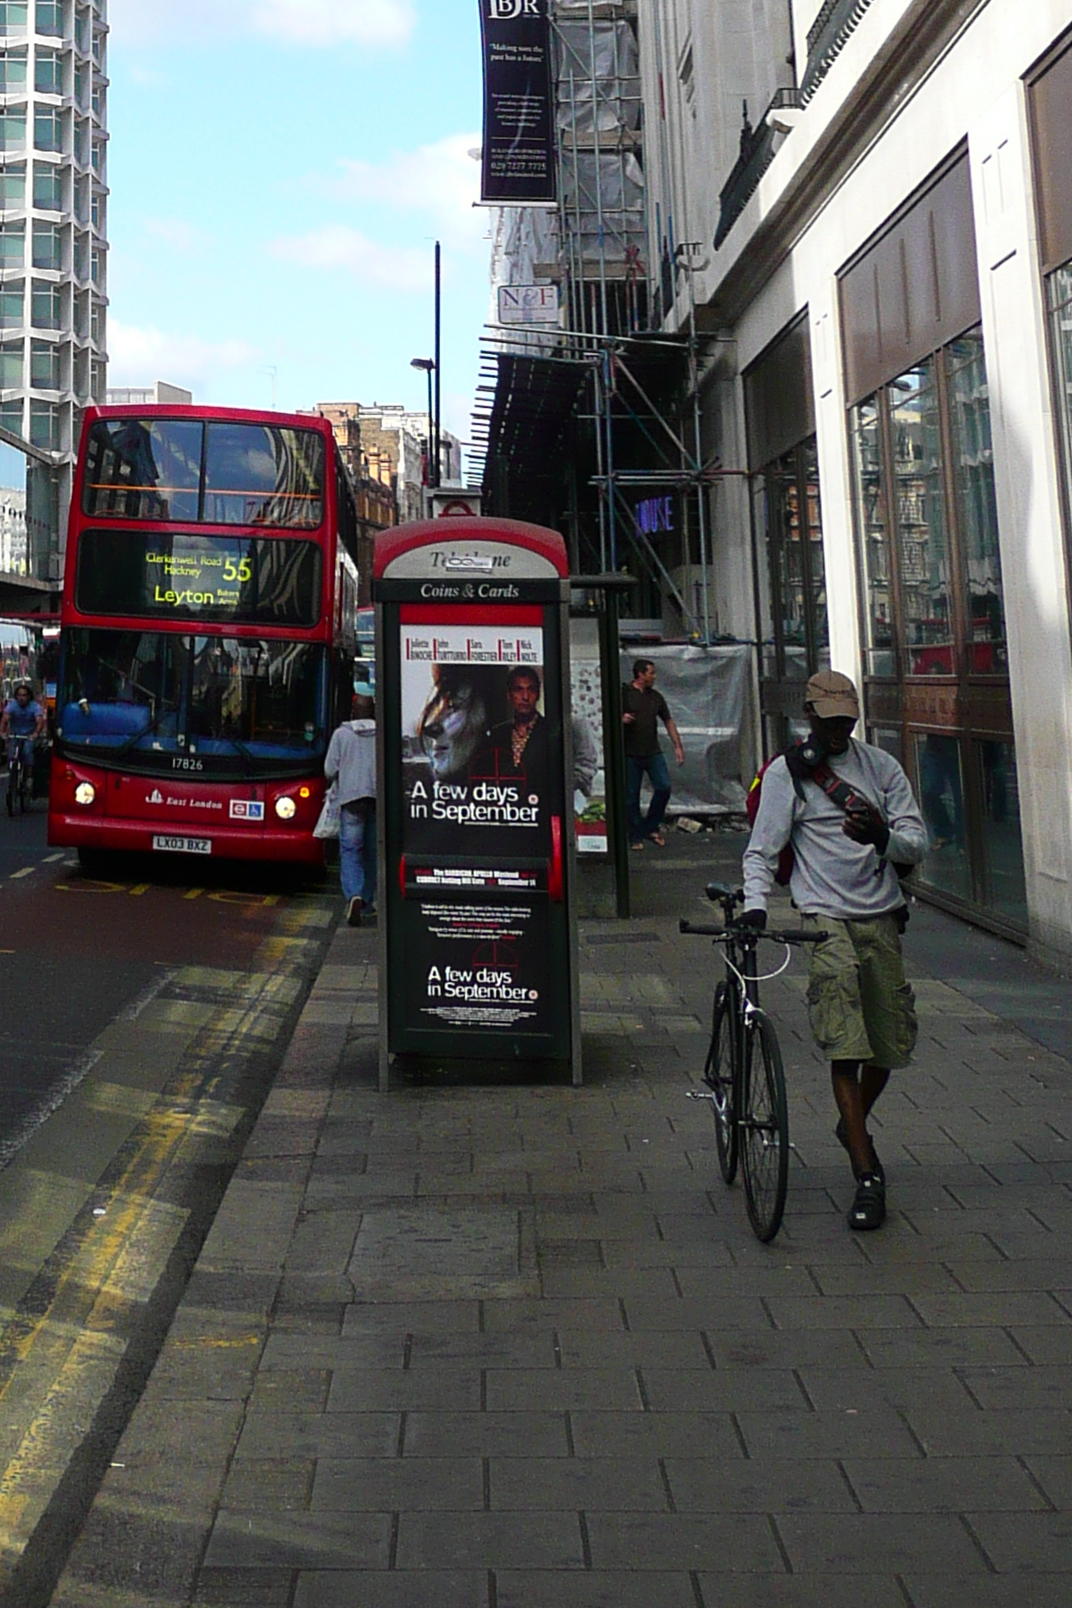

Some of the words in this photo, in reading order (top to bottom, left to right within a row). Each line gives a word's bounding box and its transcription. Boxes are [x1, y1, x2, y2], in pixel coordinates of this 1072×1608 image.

[200, 555, 222, 567] Road
[222, 557, 252, 582] 55
[164, 564, 202, 579] Hackney
[154, 585, 214, 607] Leyton
[420, 583, 460, 598] Coins
[462, 583, 475, 598] &
[478, 583, 519, 598] Cards
[172, 758, 203, 771] 17826
[411, 780, 428, 799] A
[432, 780, 468, 800] few
[473, 781, 519, 806] days
[166, 796, 187, 807] East
[189, 798, 223, 810] London
[411, 800, 428, 818] in
[432, 800, 539, 824] September
[157, 837, 184, 850] LX03
[187, 839, 208, 851] BXZ
[428, 965, 441, 981] A
[445, 966, 473, 982] few
[476, 967, 512, 987] days
[427, 981, 441, 997] in
[444, 982, 528, 1001] September
